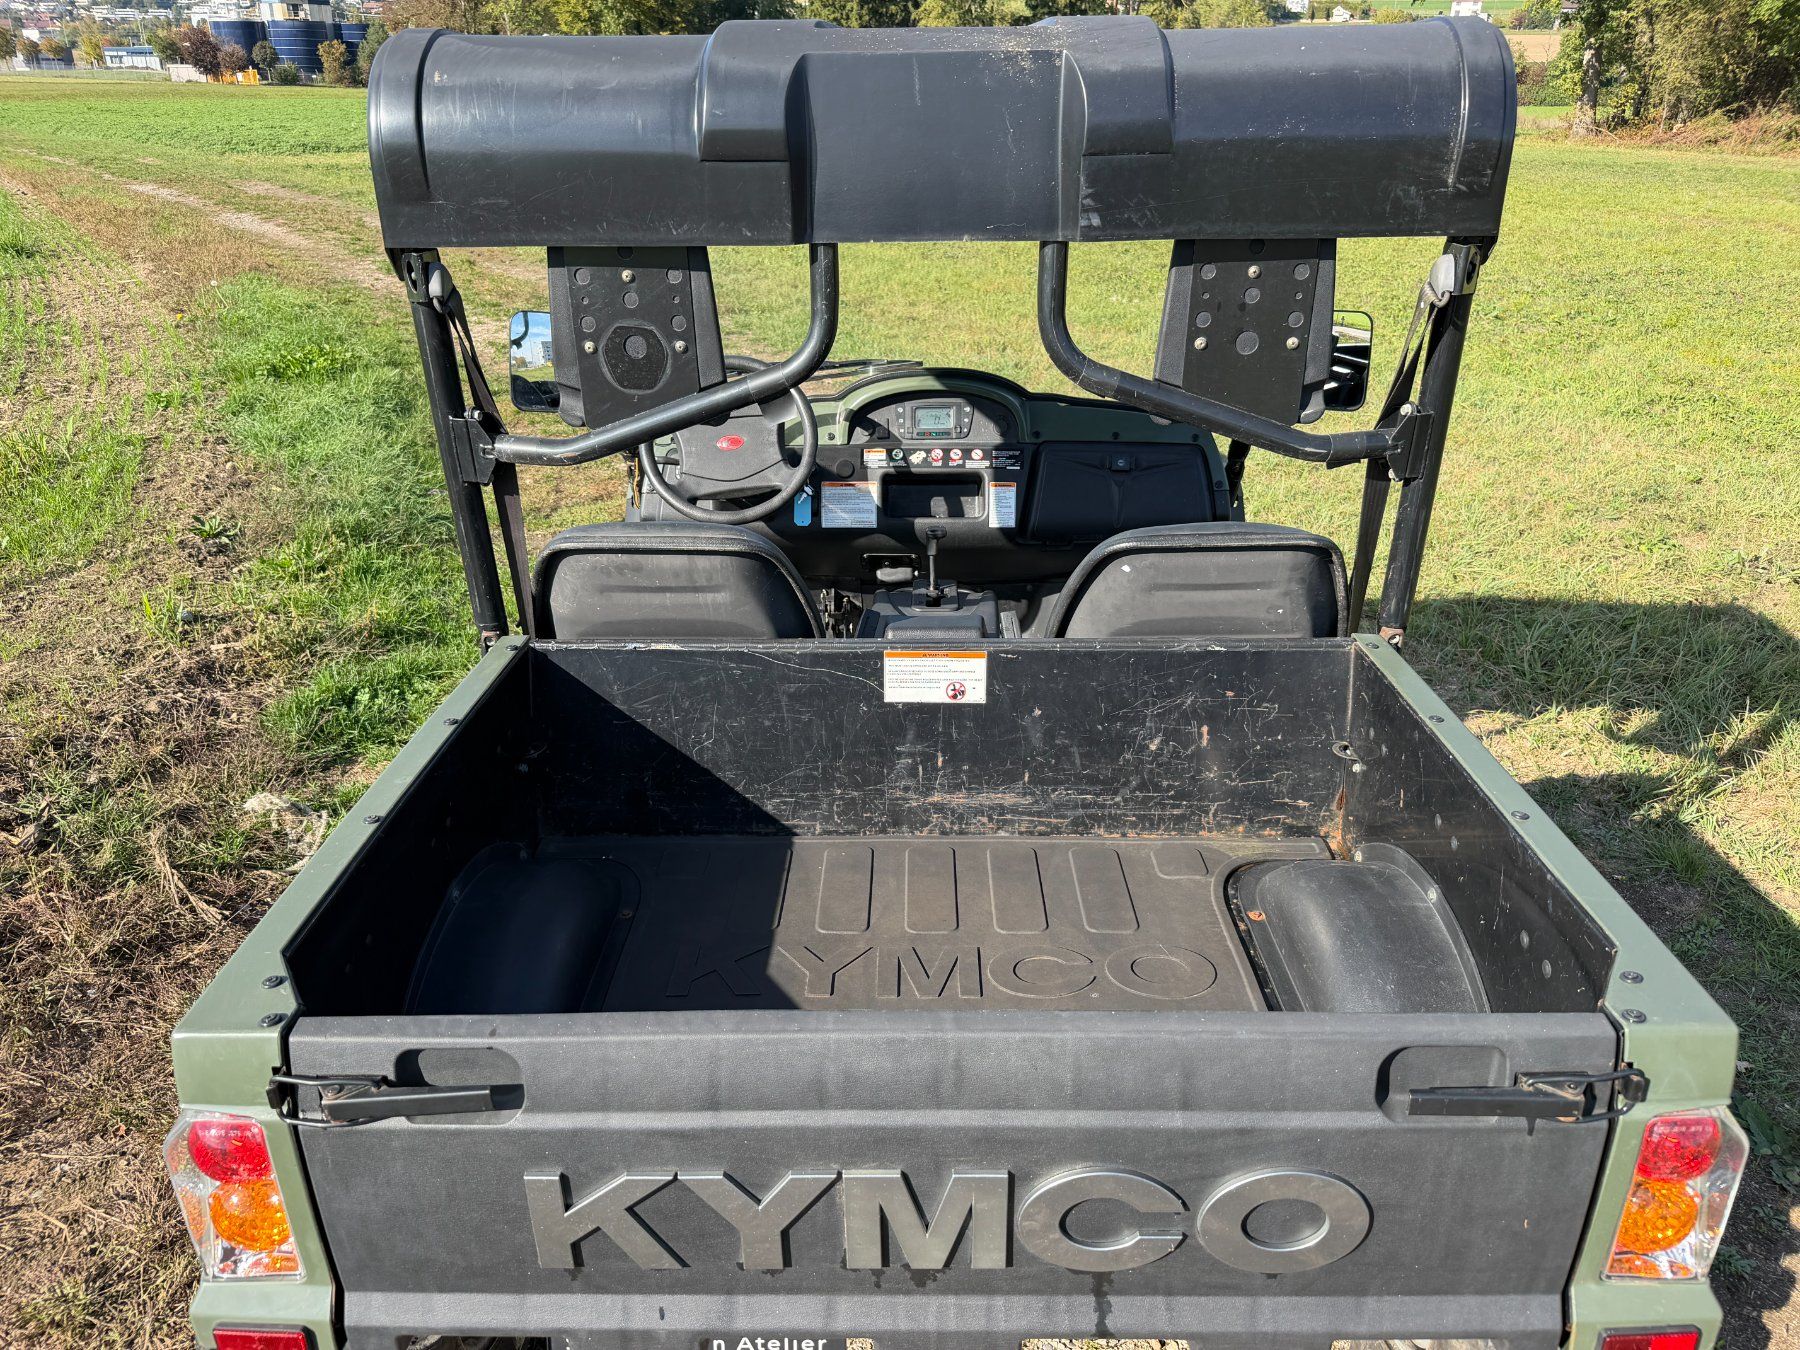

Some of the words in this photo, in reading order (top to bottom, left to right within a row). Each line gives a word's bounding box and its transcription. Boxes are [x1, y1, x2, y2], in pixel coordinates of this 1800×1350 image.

[665, 944, 1218, 999] KYMCO
[523, 1167, 1374, 1272] KYMCO
[737, 1337, 827, 1350] Atelier
